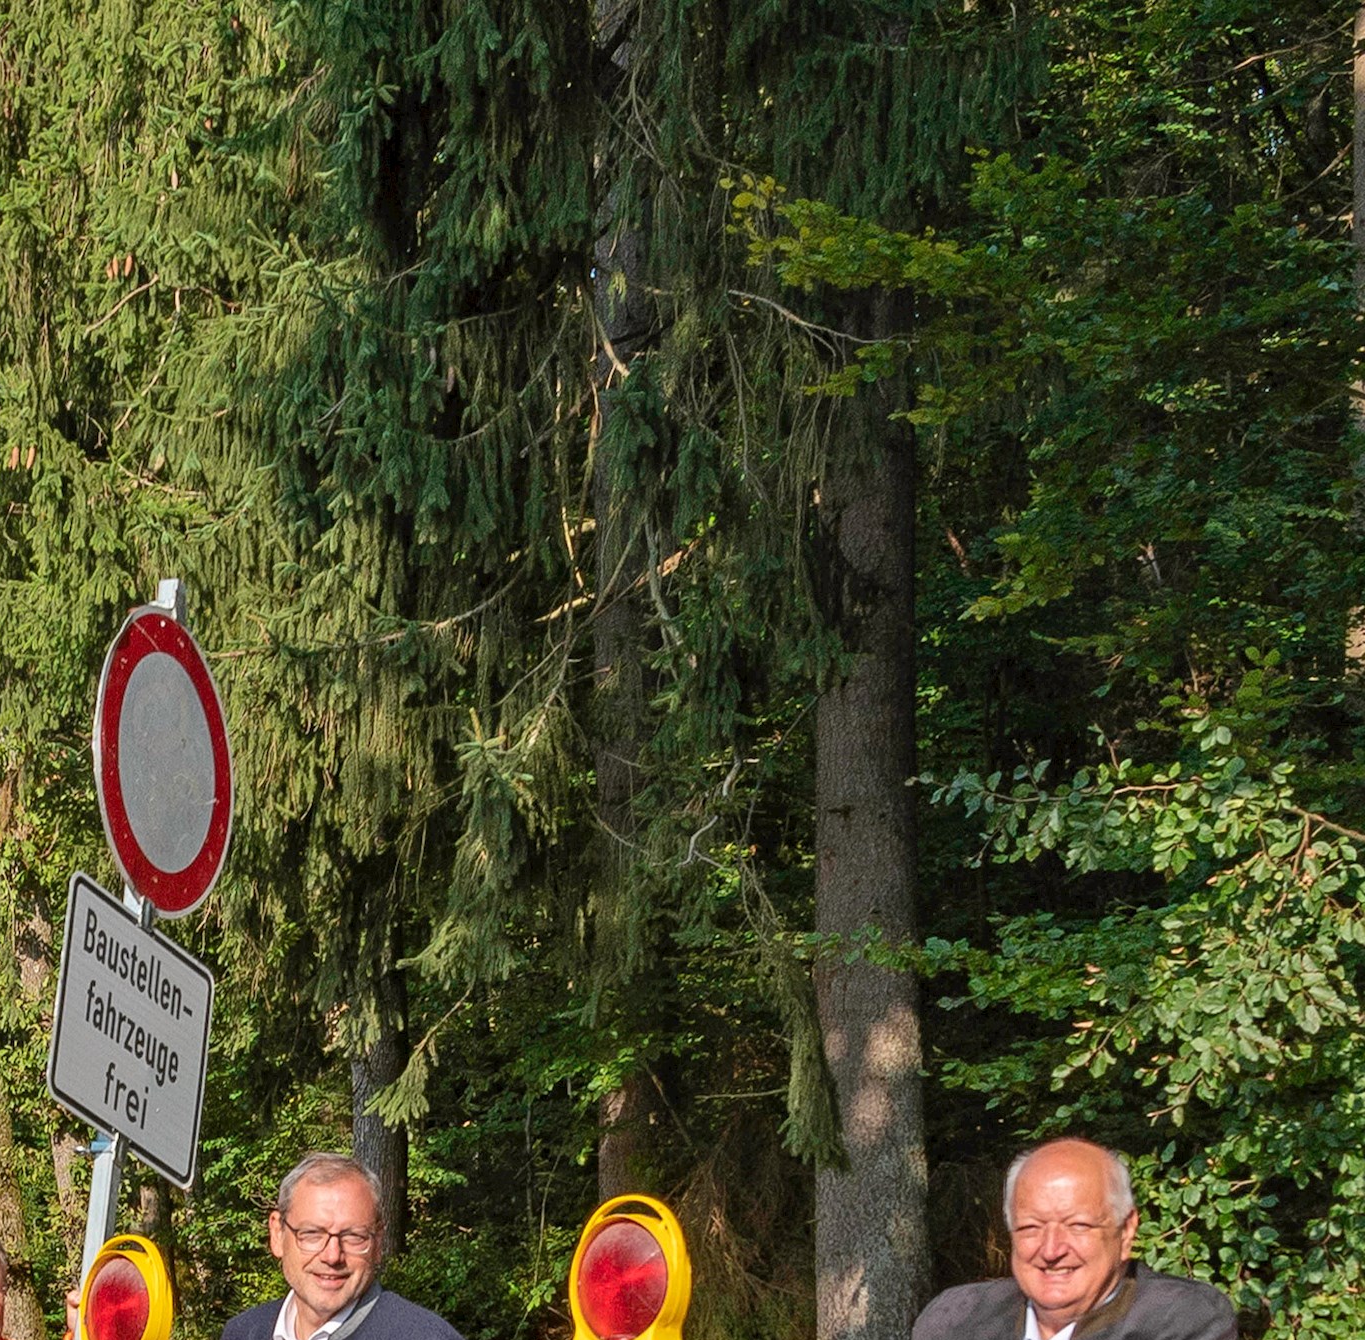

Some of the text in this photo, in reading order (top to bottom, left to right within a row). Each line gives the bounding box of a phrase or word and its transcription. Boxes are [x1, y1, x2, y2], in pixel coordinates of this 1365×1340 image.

[83, 907, 193, 1021] Baustellen-
[85, 980, 179, 1088] fahrzeuge
[103, 1062, 150, 1130] frei
